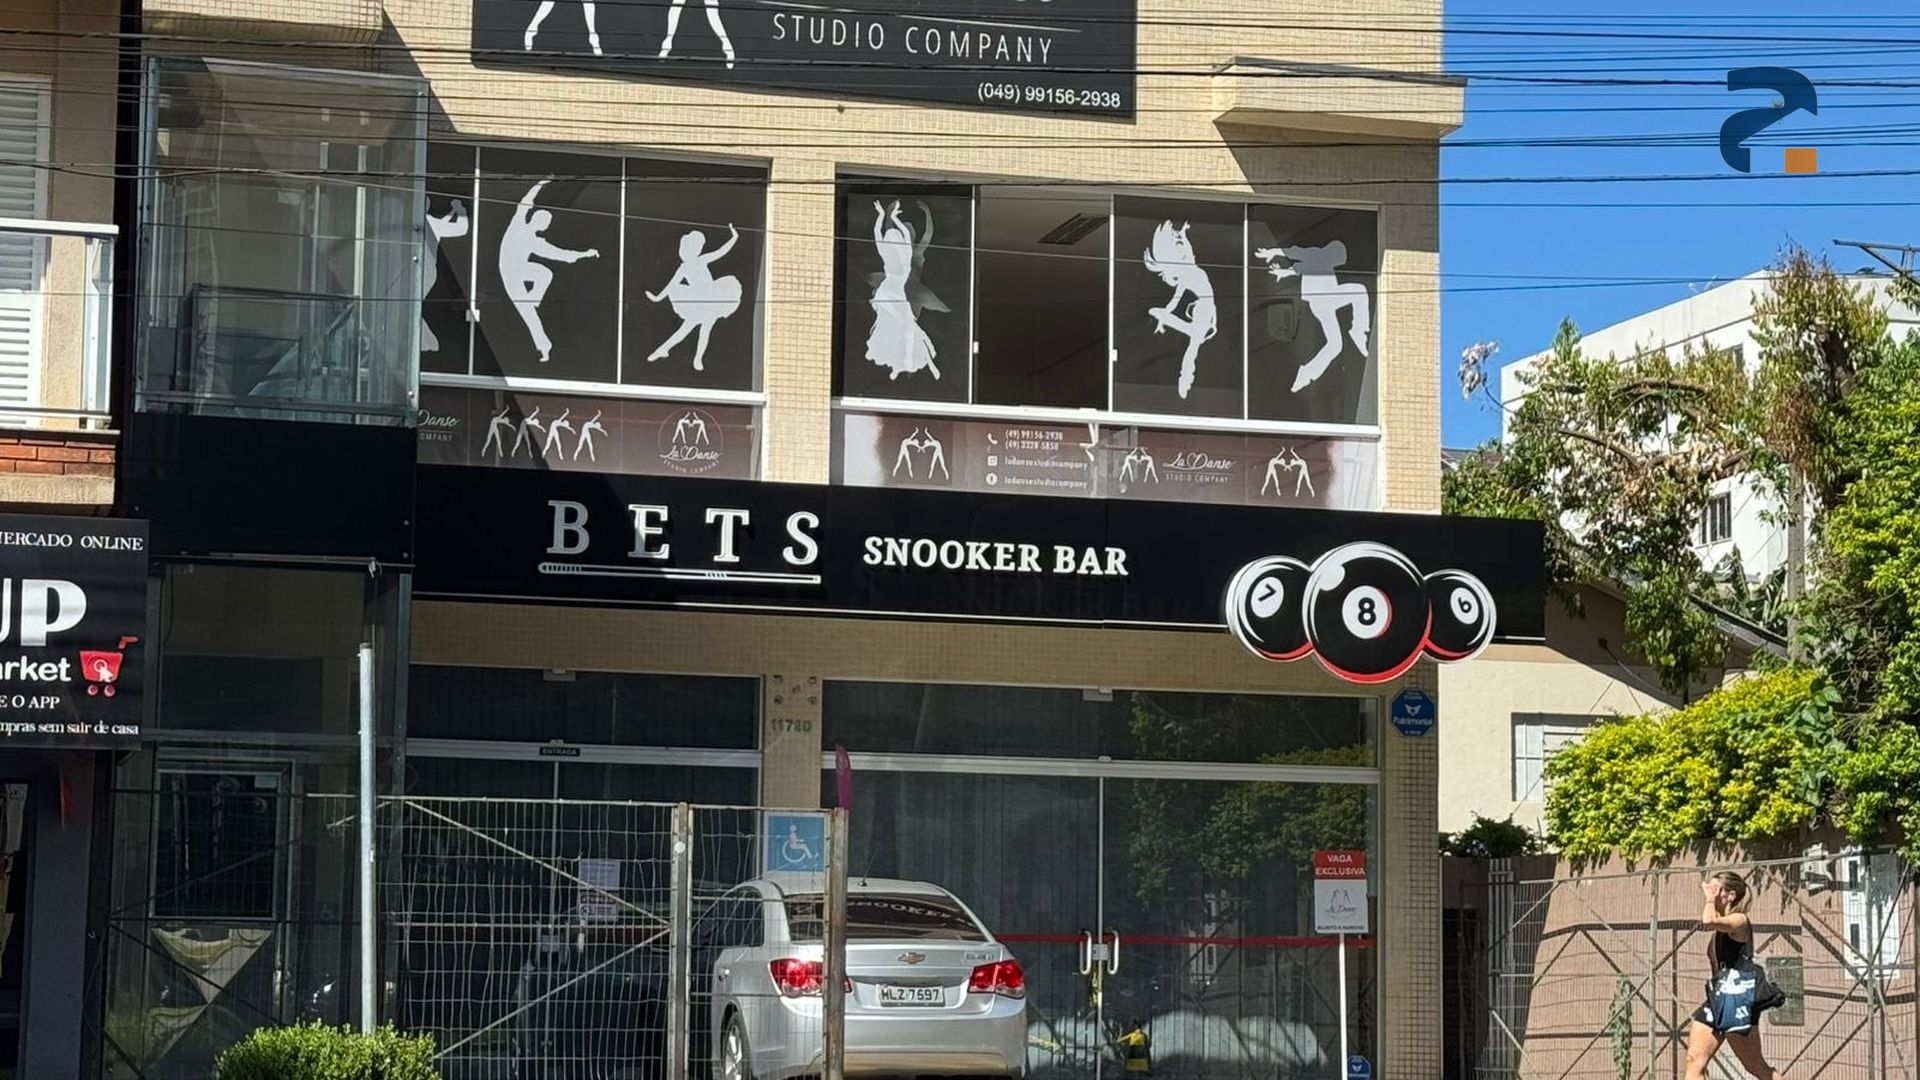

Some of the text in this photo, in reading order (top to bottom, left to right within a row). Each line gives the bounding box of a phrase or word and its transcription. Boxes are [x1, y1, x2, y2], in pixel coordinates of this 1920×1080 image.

[772, 13, 1052, 64] STUDIO COMPANY
[978, 82, 1121, 108] (049) 99156-2938
[546, 499, 820, 565] BETS
[80, 535, 144, 551] ONLINE
[863, 536, 1129, 575] SNOOKER BAR
[1258, 583, 1277, 602] 7
[1357, 597, 1377, 626] 8
[12, 694, 26, 708] O
[28, 695, 60, 709] APP
[38, 722, 64, 733] sem
[66, 722, 92, 734] sair
[93, 720, 109, 734] de
[111, 724, 139, 735] casa
[1327, 853, 1352, 862] VAGA
[1315, 866, 1365, 876] EXCLUSIVA
